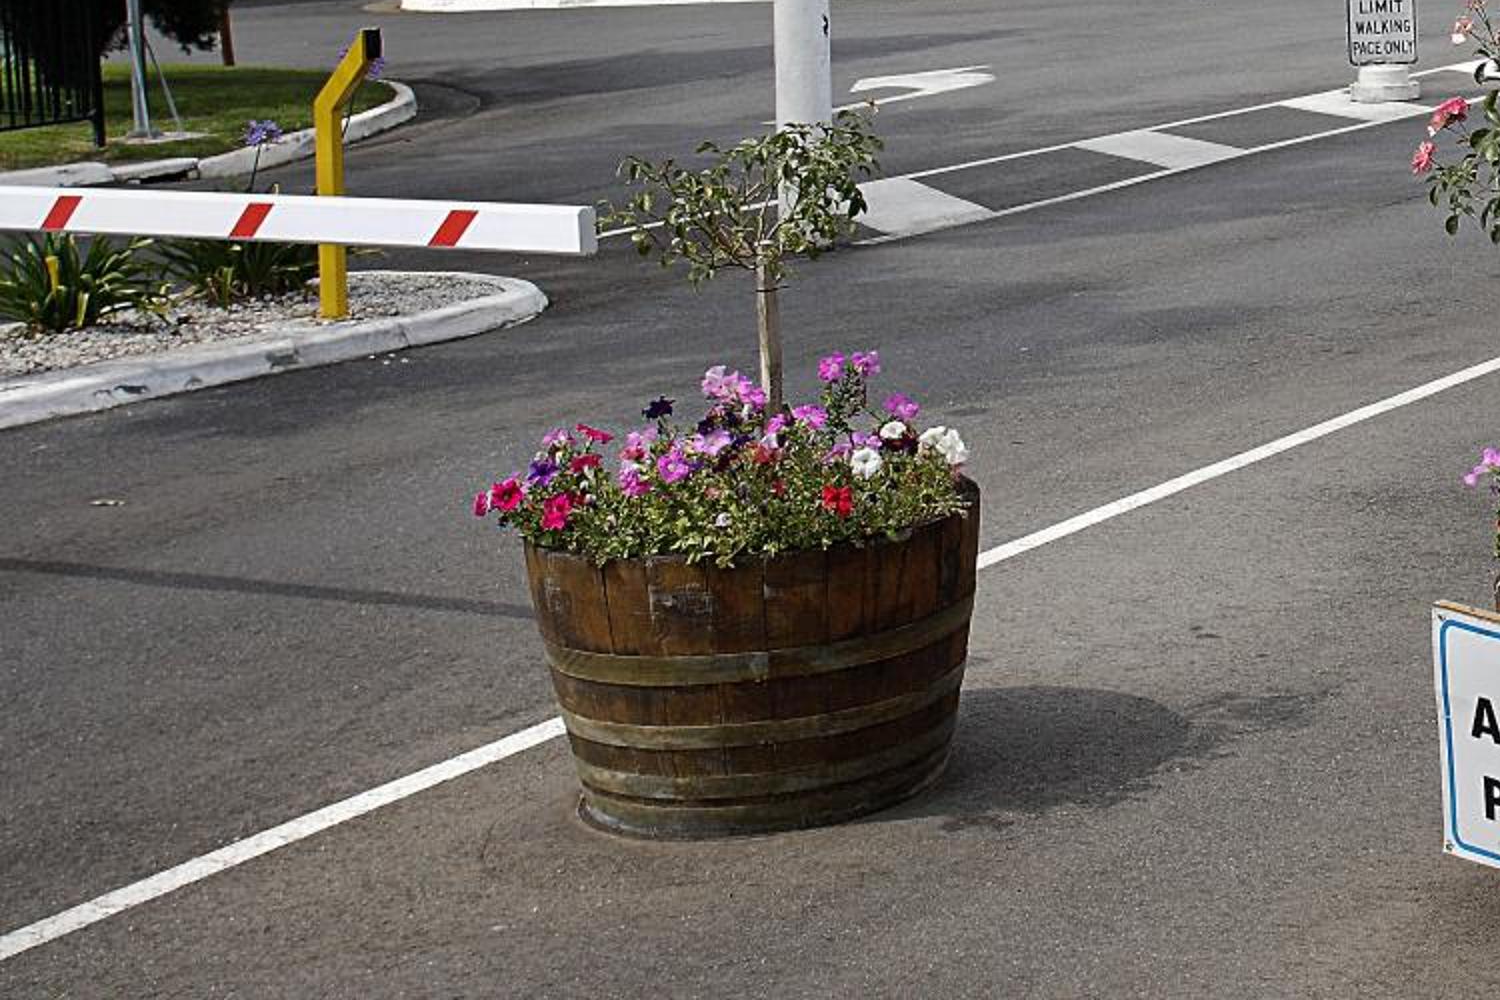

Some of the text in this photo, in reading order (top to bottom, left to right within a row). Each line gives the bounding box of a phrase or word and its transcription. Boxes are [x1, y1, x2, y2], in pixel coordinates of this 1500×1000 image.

[1359, 0, 1403, 15] LIMIT
[1355, 19, 1411, 35] WALKING
[1353, 39, 1414, 57] PACE ONLY
